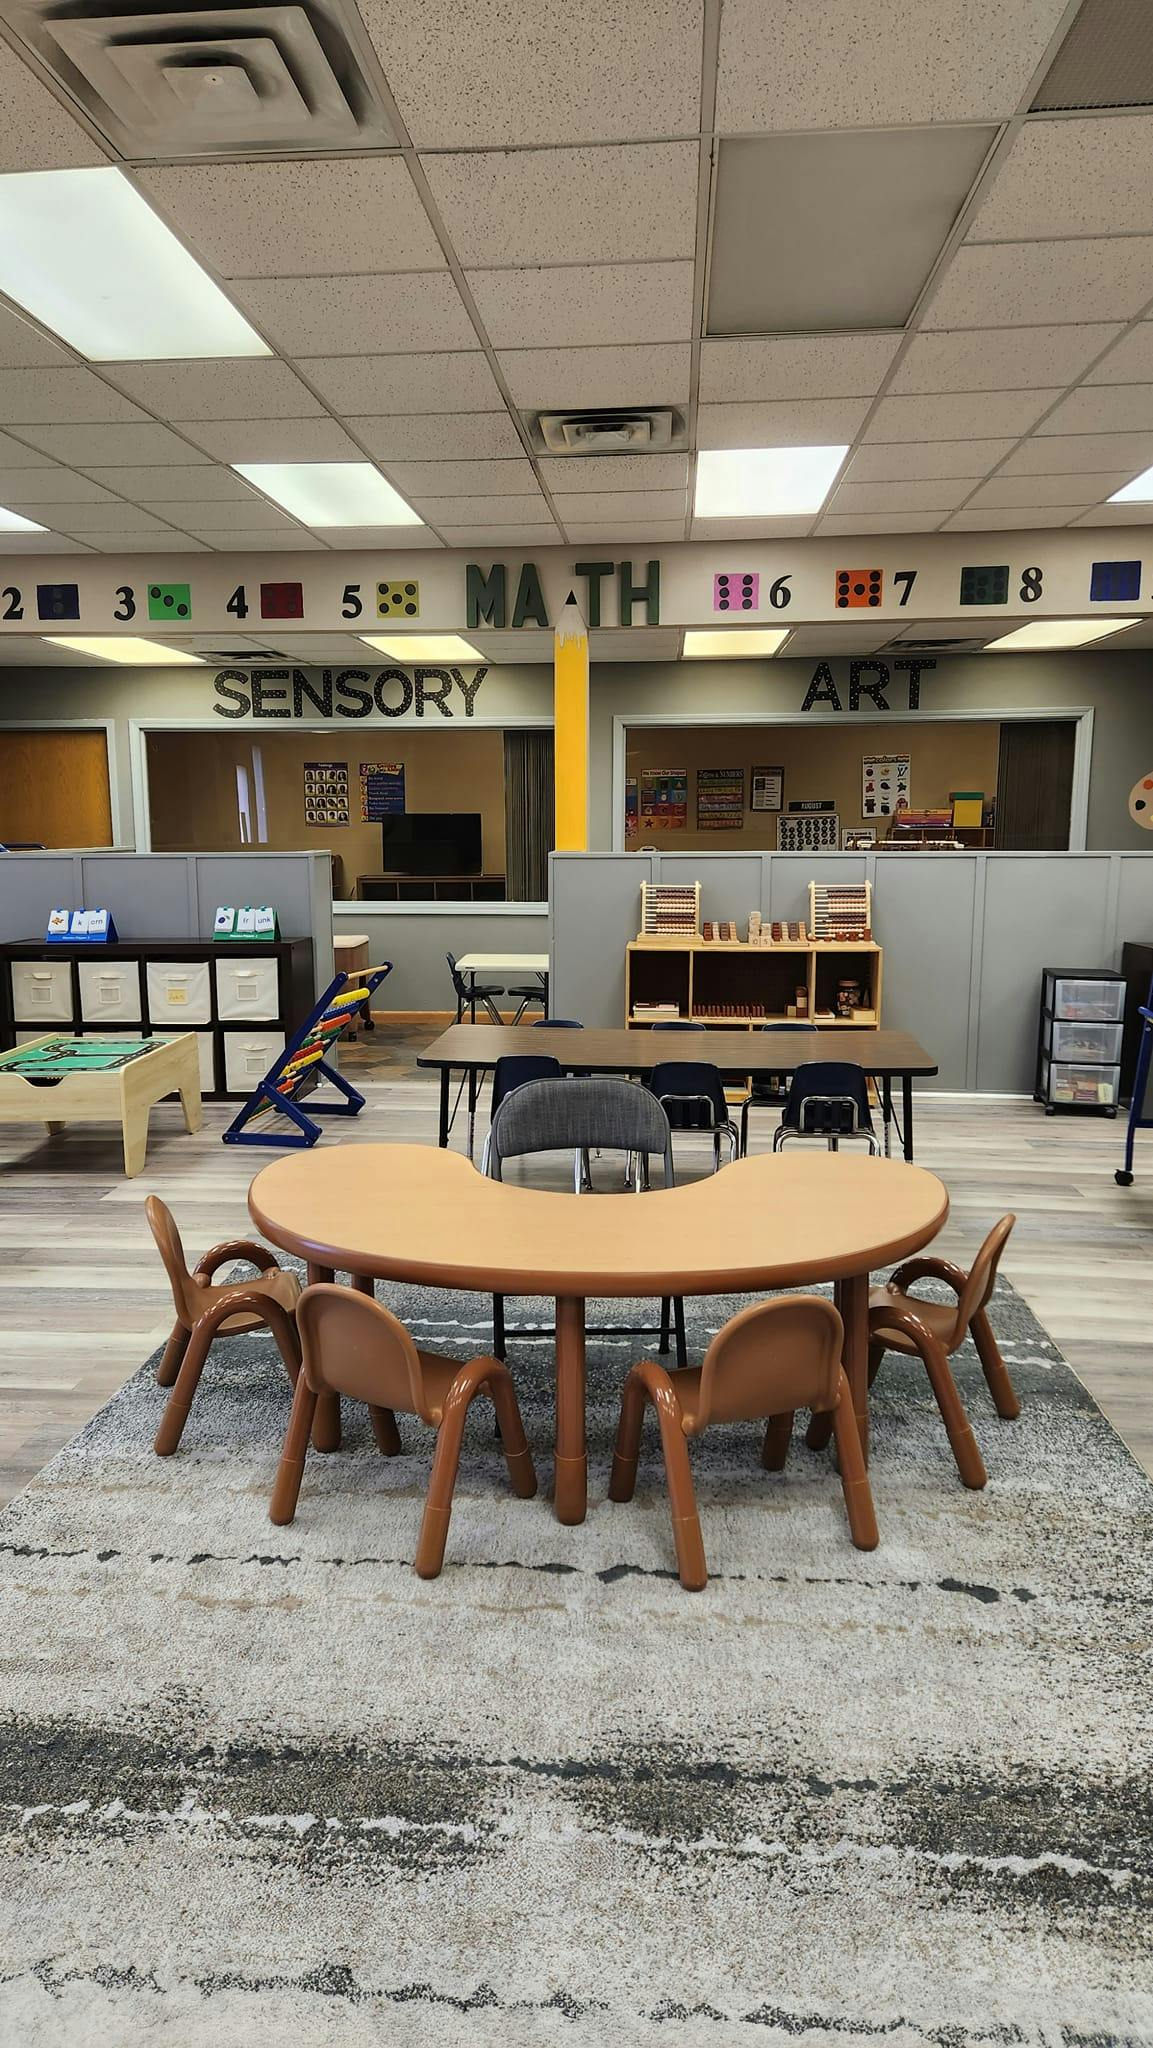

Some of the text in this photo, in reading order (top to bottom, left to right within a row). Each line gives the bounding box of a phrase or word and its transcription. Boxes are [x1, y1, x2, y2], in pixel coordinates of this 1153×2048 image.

[226, 585, 249, 619] 4
[341, 584, 363, 619] 5
[465, 559, 661, 628] MATH
[769, 574, 793, 609] 6
[893, 570, 918, 606] 7
[1019, 566, 1044, 603] 8
[1, 586, 25, 620] 2
[113, 586, 136, 621] 3
[212, 667, 489, 719] SENSORY
[800, 658, 938, 712] ART
[801, 802, 822, 810] AUGUST
